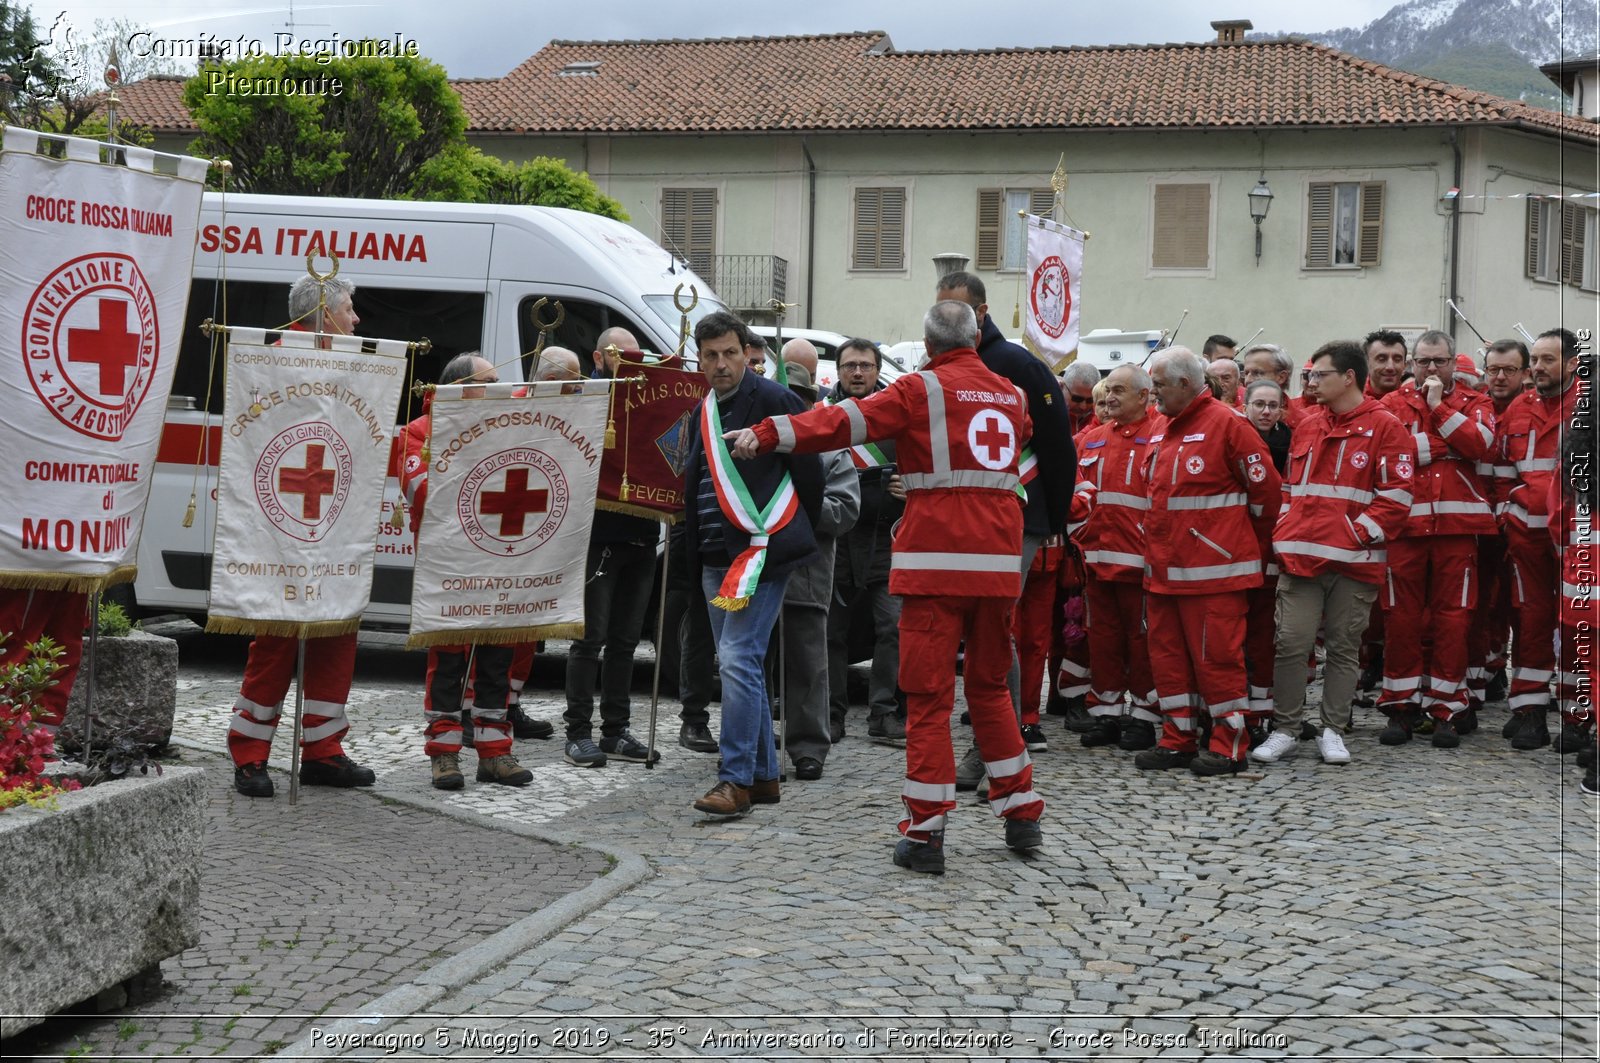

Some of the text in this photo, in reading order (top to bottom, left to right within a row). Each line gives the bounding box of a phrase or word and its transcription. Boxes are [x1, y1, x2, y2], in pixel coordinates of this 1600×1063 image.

[26, 195, 173, 237] CROCE ROSSA ITALIANA
[196, 225, 428, 262] SSA ITALIANA
[29, 261, 123, 360] CONVENZIONE
[136, 285, 154, 368] GINEVRA
[234, 353, 398, 376] CORPO VOLONTARI DEL SOCCORSO
[48, 387, 75, 413] 22
[956, 389, 978, 402] CROCE
[977, 391, 995, 403] ROSSA
[229, 382, 385, 447] CROCE ROSSA ITALIANA
[281, 433, 295, 446] DI
[296, 426, 334, 444] GINEVRA
[332, 440, 345, 453] 22
[435, 411, 598, 474] CROCE ROSSA ITALIANA
[25, 461, 114, 485] COMITATO
[258, 441, 285, 523] CONVENZIONE
[337, 454, 351, 502] AGOSTO
[102, 489, 114, 510] di
[460, 451, 566, 542] CONVENZIONE DI GINEVRA 22 AGOSTO 1864
[227, 562, 307, 578] COMITATO
[349, 564, 361, 576] DI
[442, 573, 564, 591] COMITATO LOCALE
[440, 598, 558, 617] LIMONE PIEMONTE
[498, 593, 509, 602] DI
